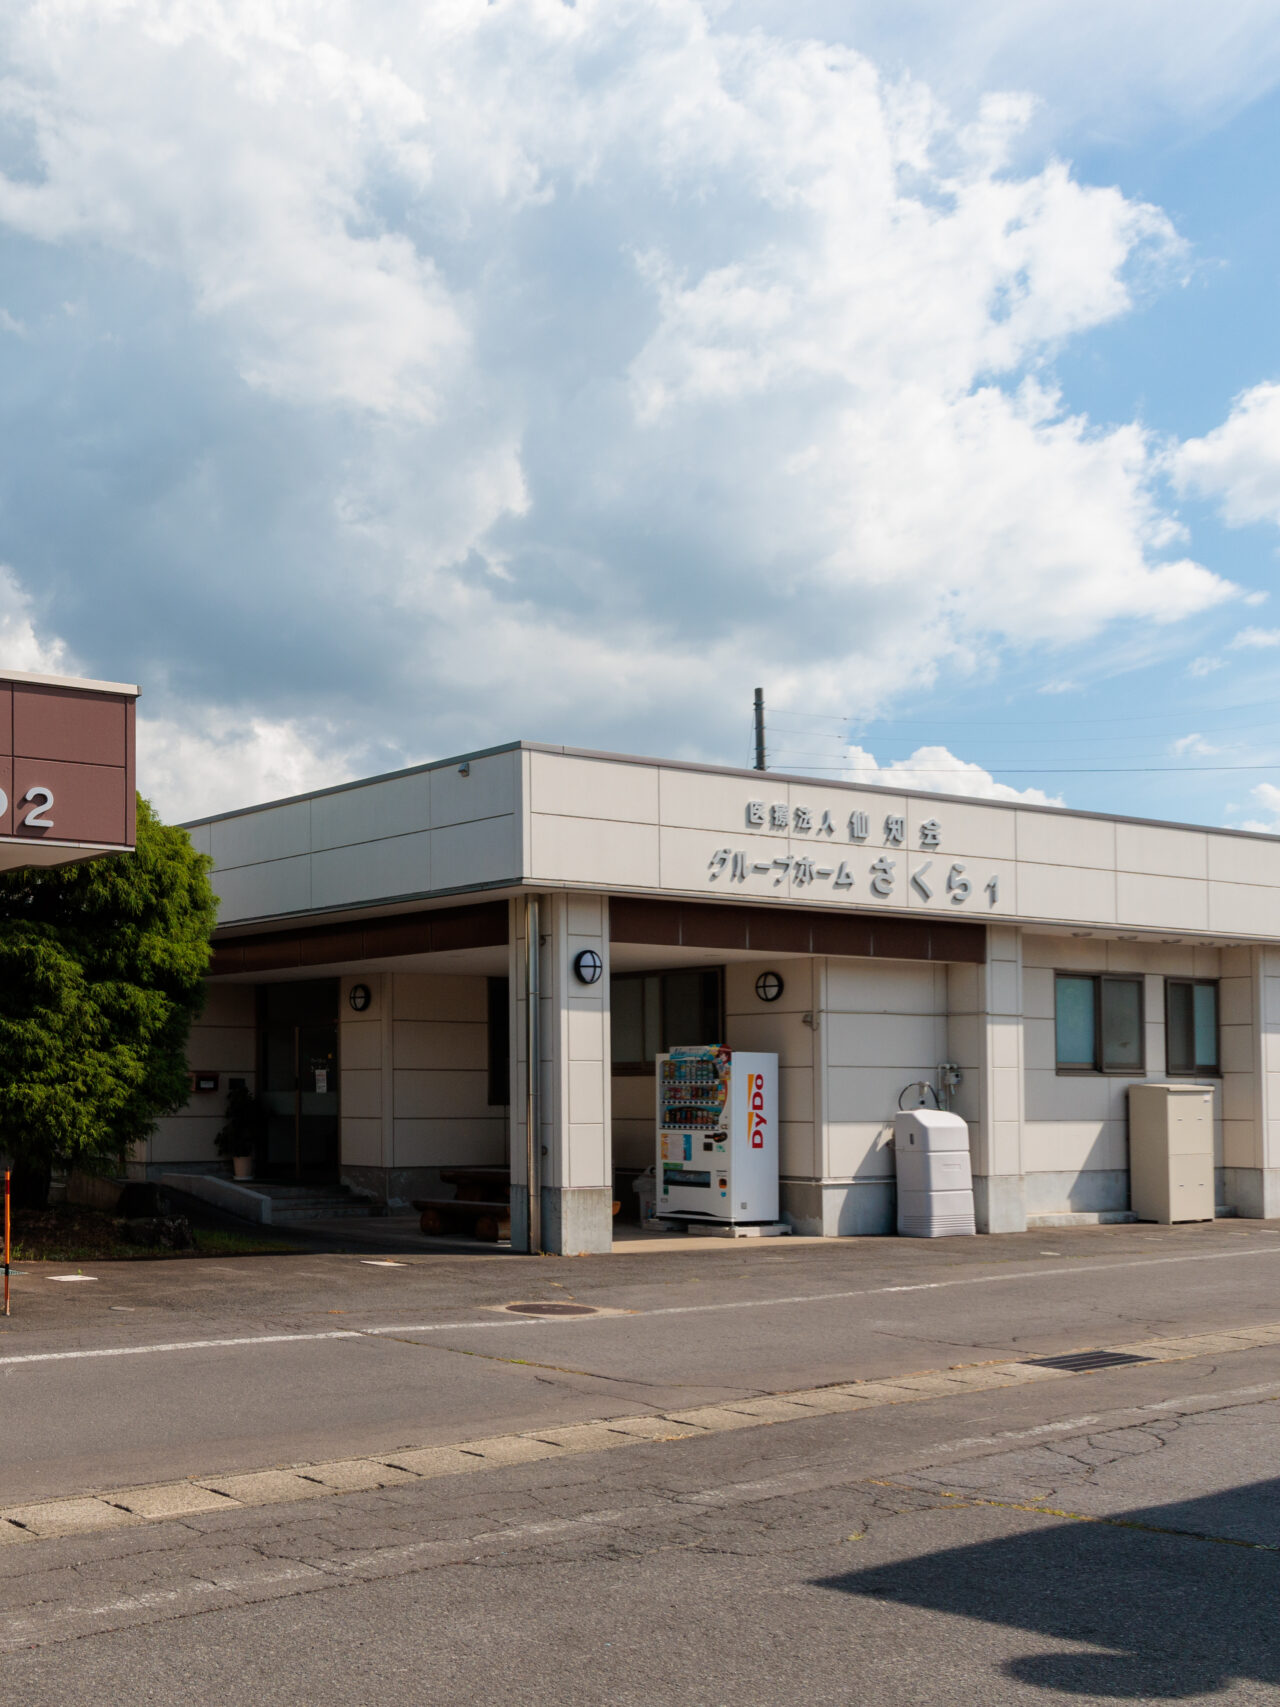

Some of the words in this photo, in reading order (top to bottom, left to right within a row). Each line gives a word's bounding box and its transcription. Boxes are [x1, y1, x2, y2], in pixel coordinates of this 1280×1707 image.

[747, 800, 942, 846] 医療法人仙知会
[751, 1073, 768, 1149] DyDo
